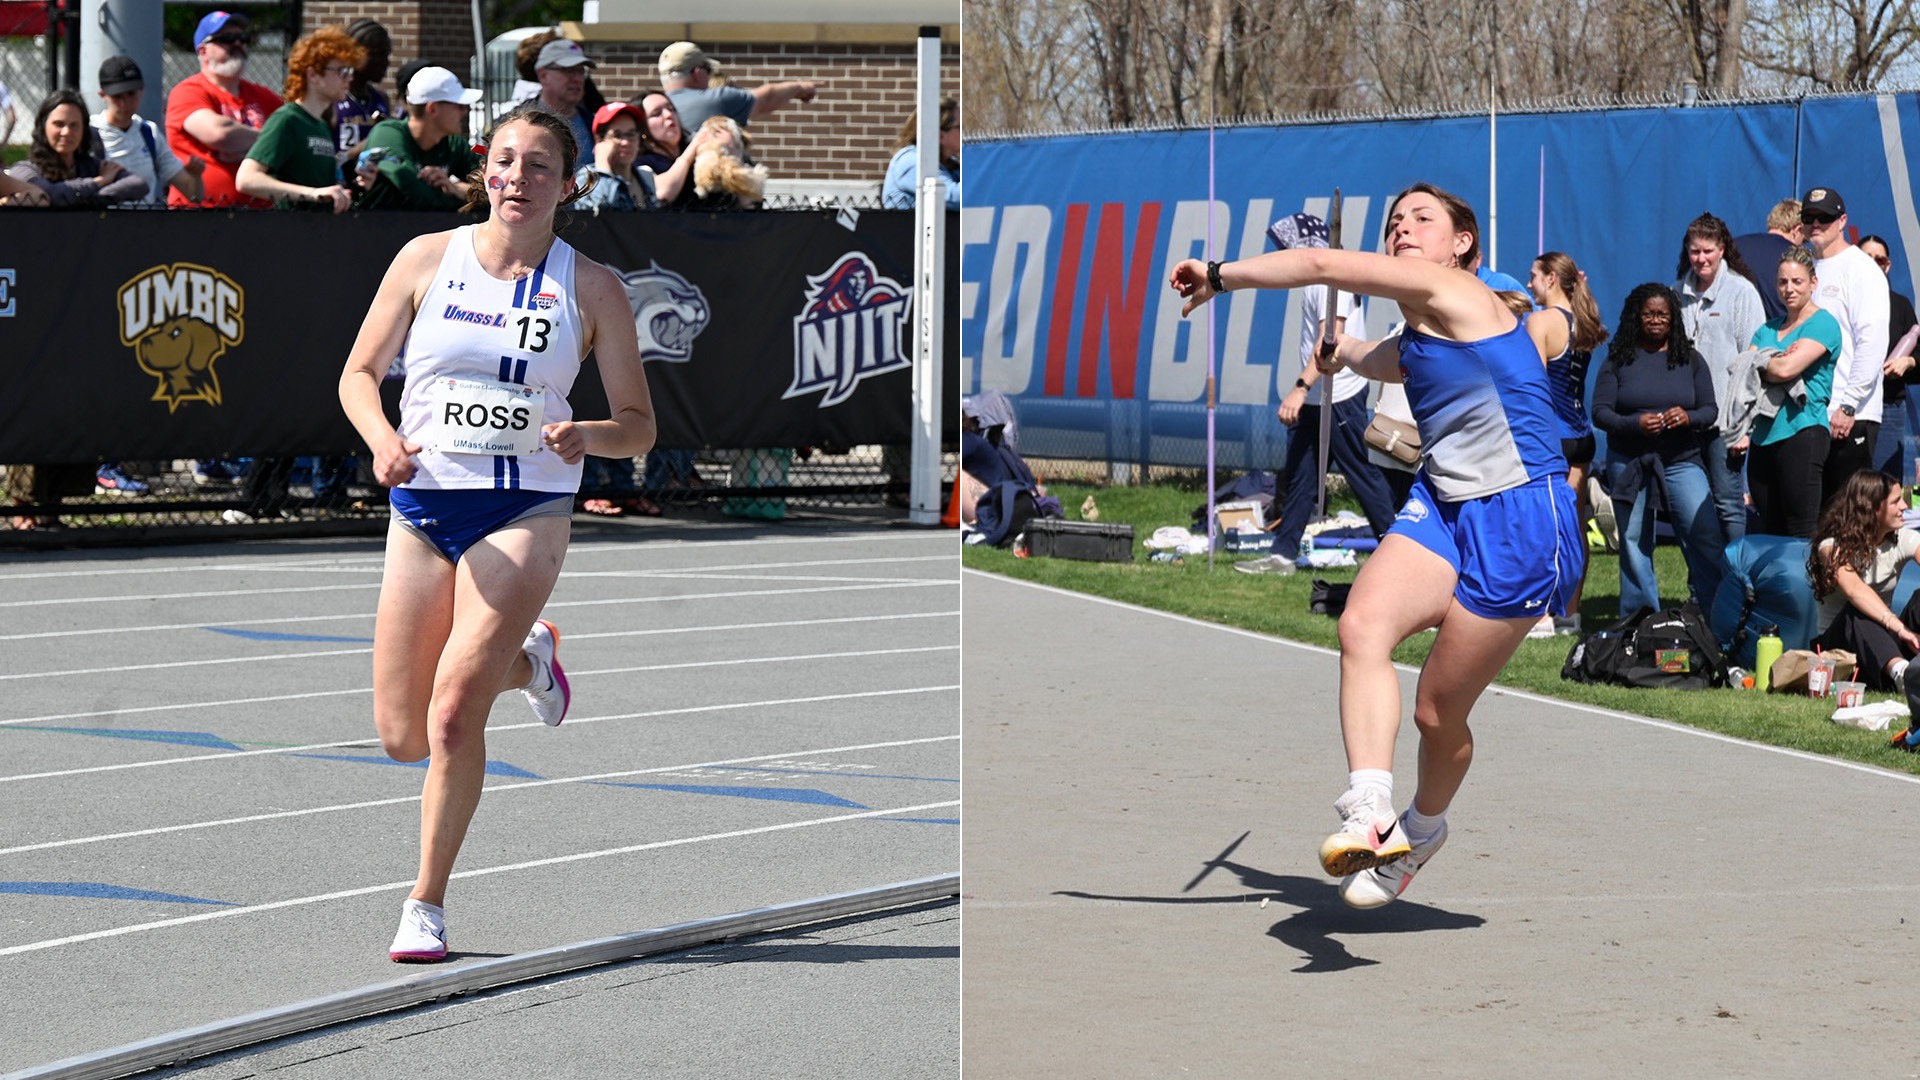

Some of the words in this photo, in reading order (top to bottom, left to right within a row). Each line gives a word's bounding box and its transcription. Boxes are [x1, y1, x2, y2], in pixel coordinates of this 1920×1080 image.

[123, 269, 239, 340] UMBC
[516, 316, 551, 353] 13
[802, 300, 904, 391] NJIT
[444, 402, 530, 431] ROSS
[453, 439, 483, 450] UMass
[485, 442, 514, 452] Lowell
